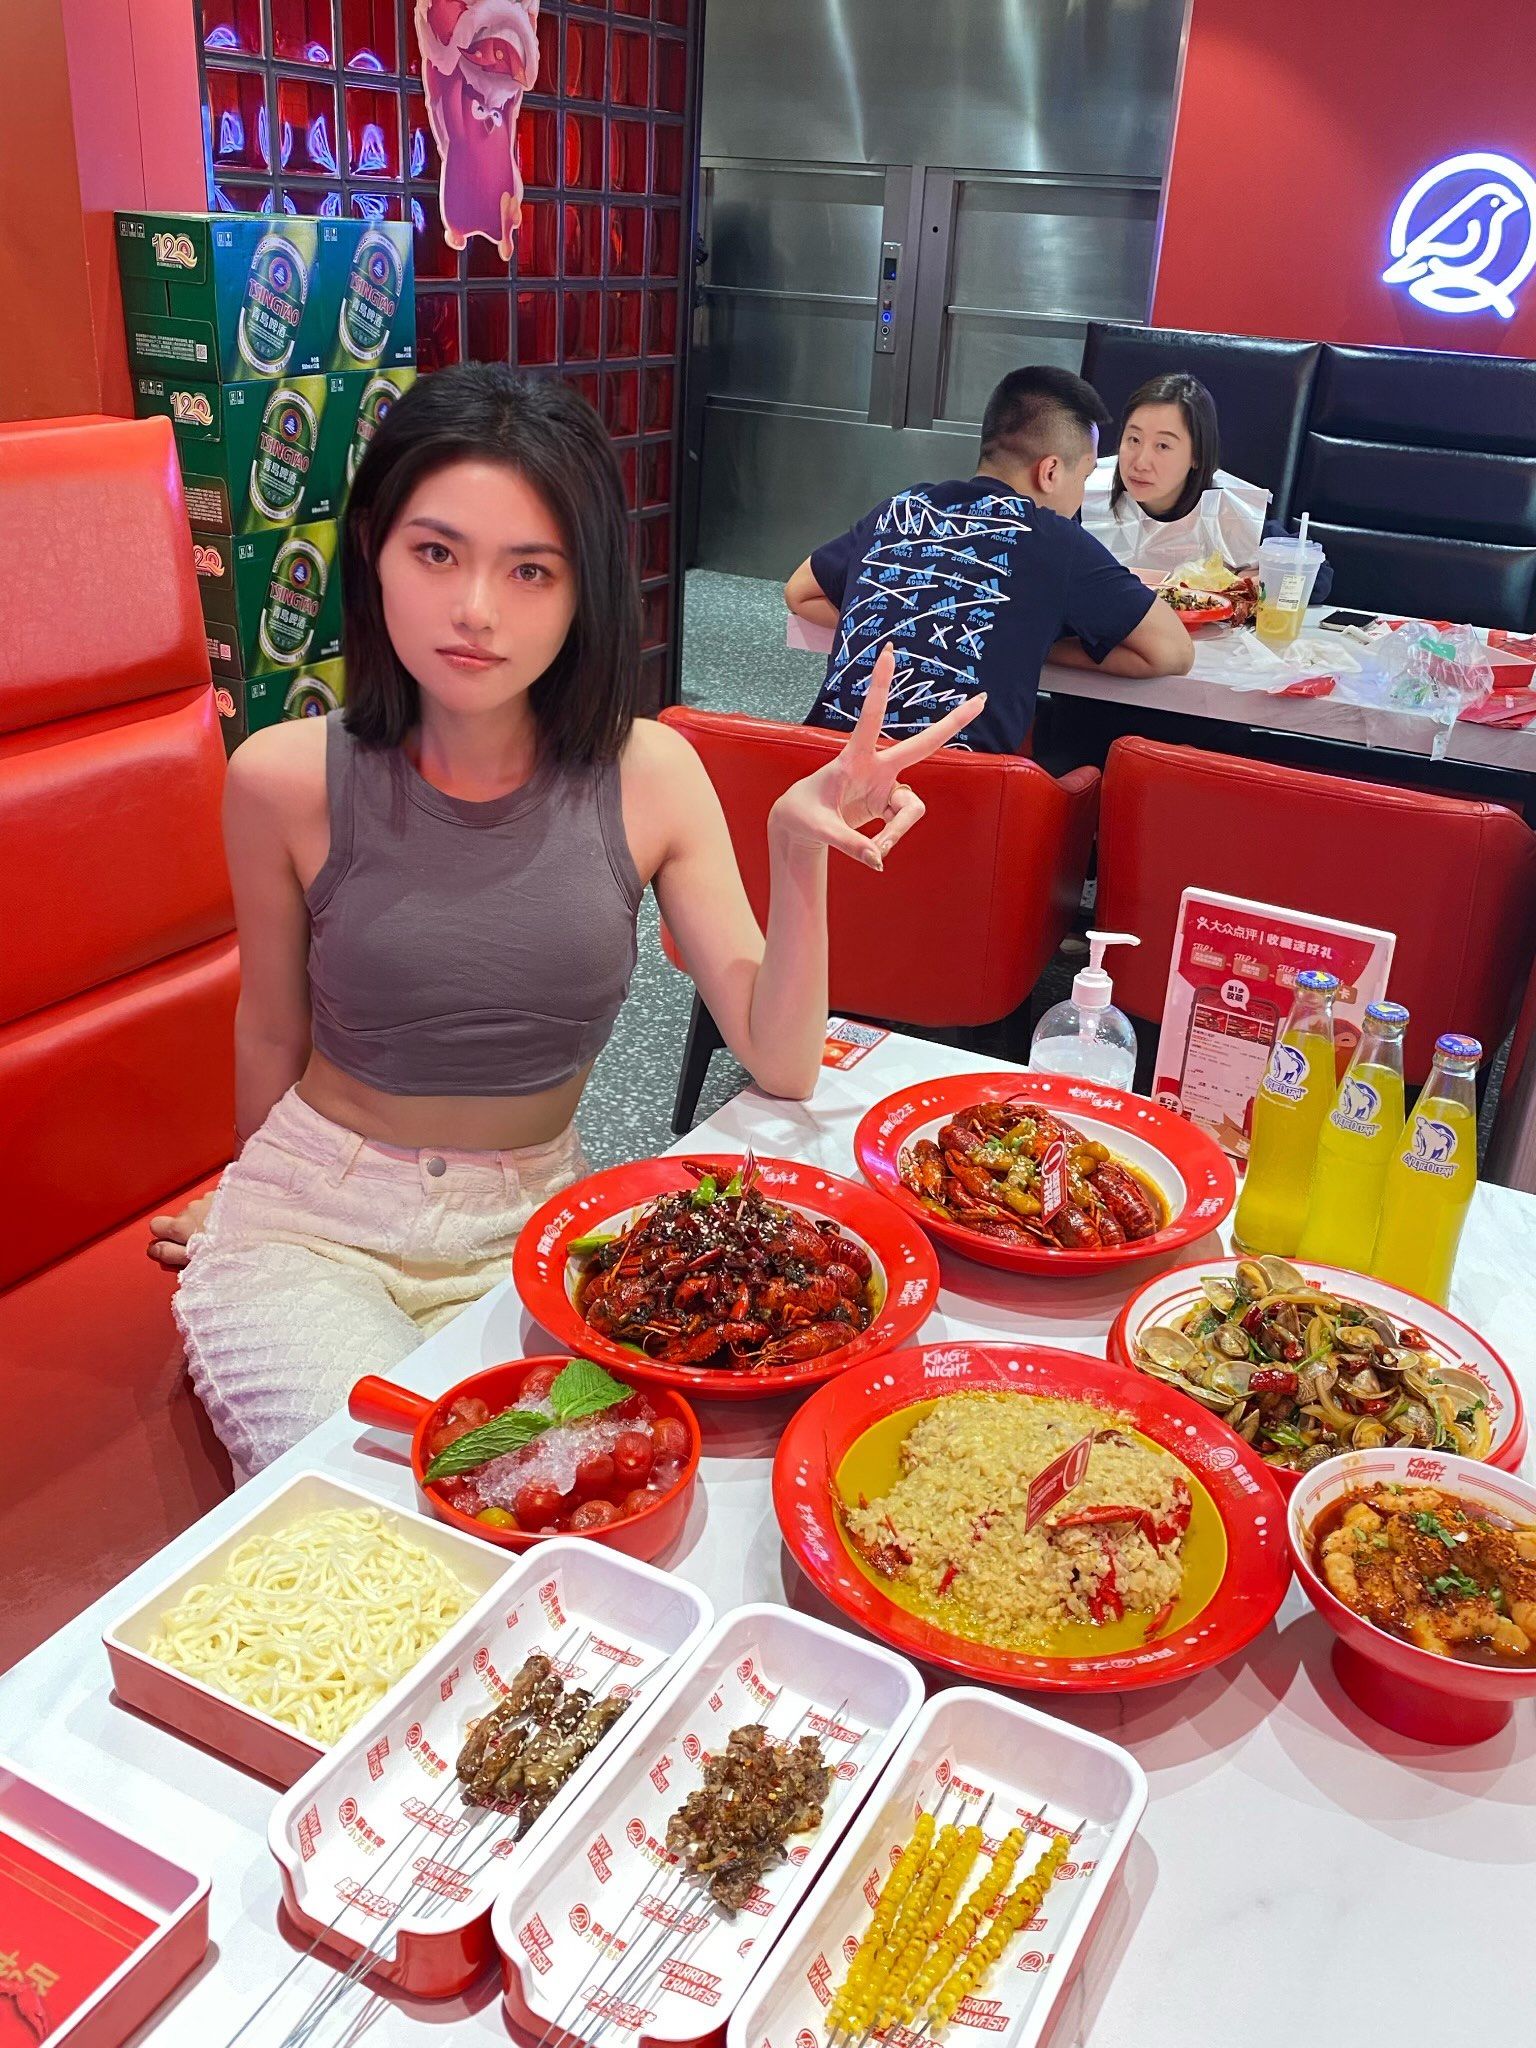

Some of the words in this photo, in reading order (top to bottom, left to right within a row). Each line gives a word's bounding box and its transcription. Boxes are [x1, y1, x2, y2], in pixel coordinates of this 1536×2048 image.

[249, 277, 300, 327] TSINGTAO
[350, 271, 396, 317] TSINGTAO
[251, 306, 288, 339] 青岛啤酒
[351, 298, 385, 328] 青岛啤酒
[260, 432, 310, 473] TSINGTAO
[262, 457, 297, 486] 青岛啤酒
[269, 581, 320, 617] TSINGTAO
[272, 606, 306, 631] 青岛啤酒
[1210, 920, 1258, 942] 大众点评
[1266, 933, 1333, 960] 收藏送好礼
[922, 1349, 960, 1367] KING
[1408, 1457, 1437, 1470] KING
[550, 1596, 567, 1625] 麻雀牌
[751, 1674, 777, 1701] 麻雀牌
[420, 1740, 448, 1773] 麻雀牌
[951, 1776, 985, 1798] 麻雀牌
[355, 1816, 386, 1849] 麻雀牌
[646, 1836, 680, 1865] 麻雀牌
[590, 1922, 629, 1952] 麻雀牌
[659, 1958, 723, 1989] SPARROW
[660, 1974, 723, 2008] CRAWFISH
